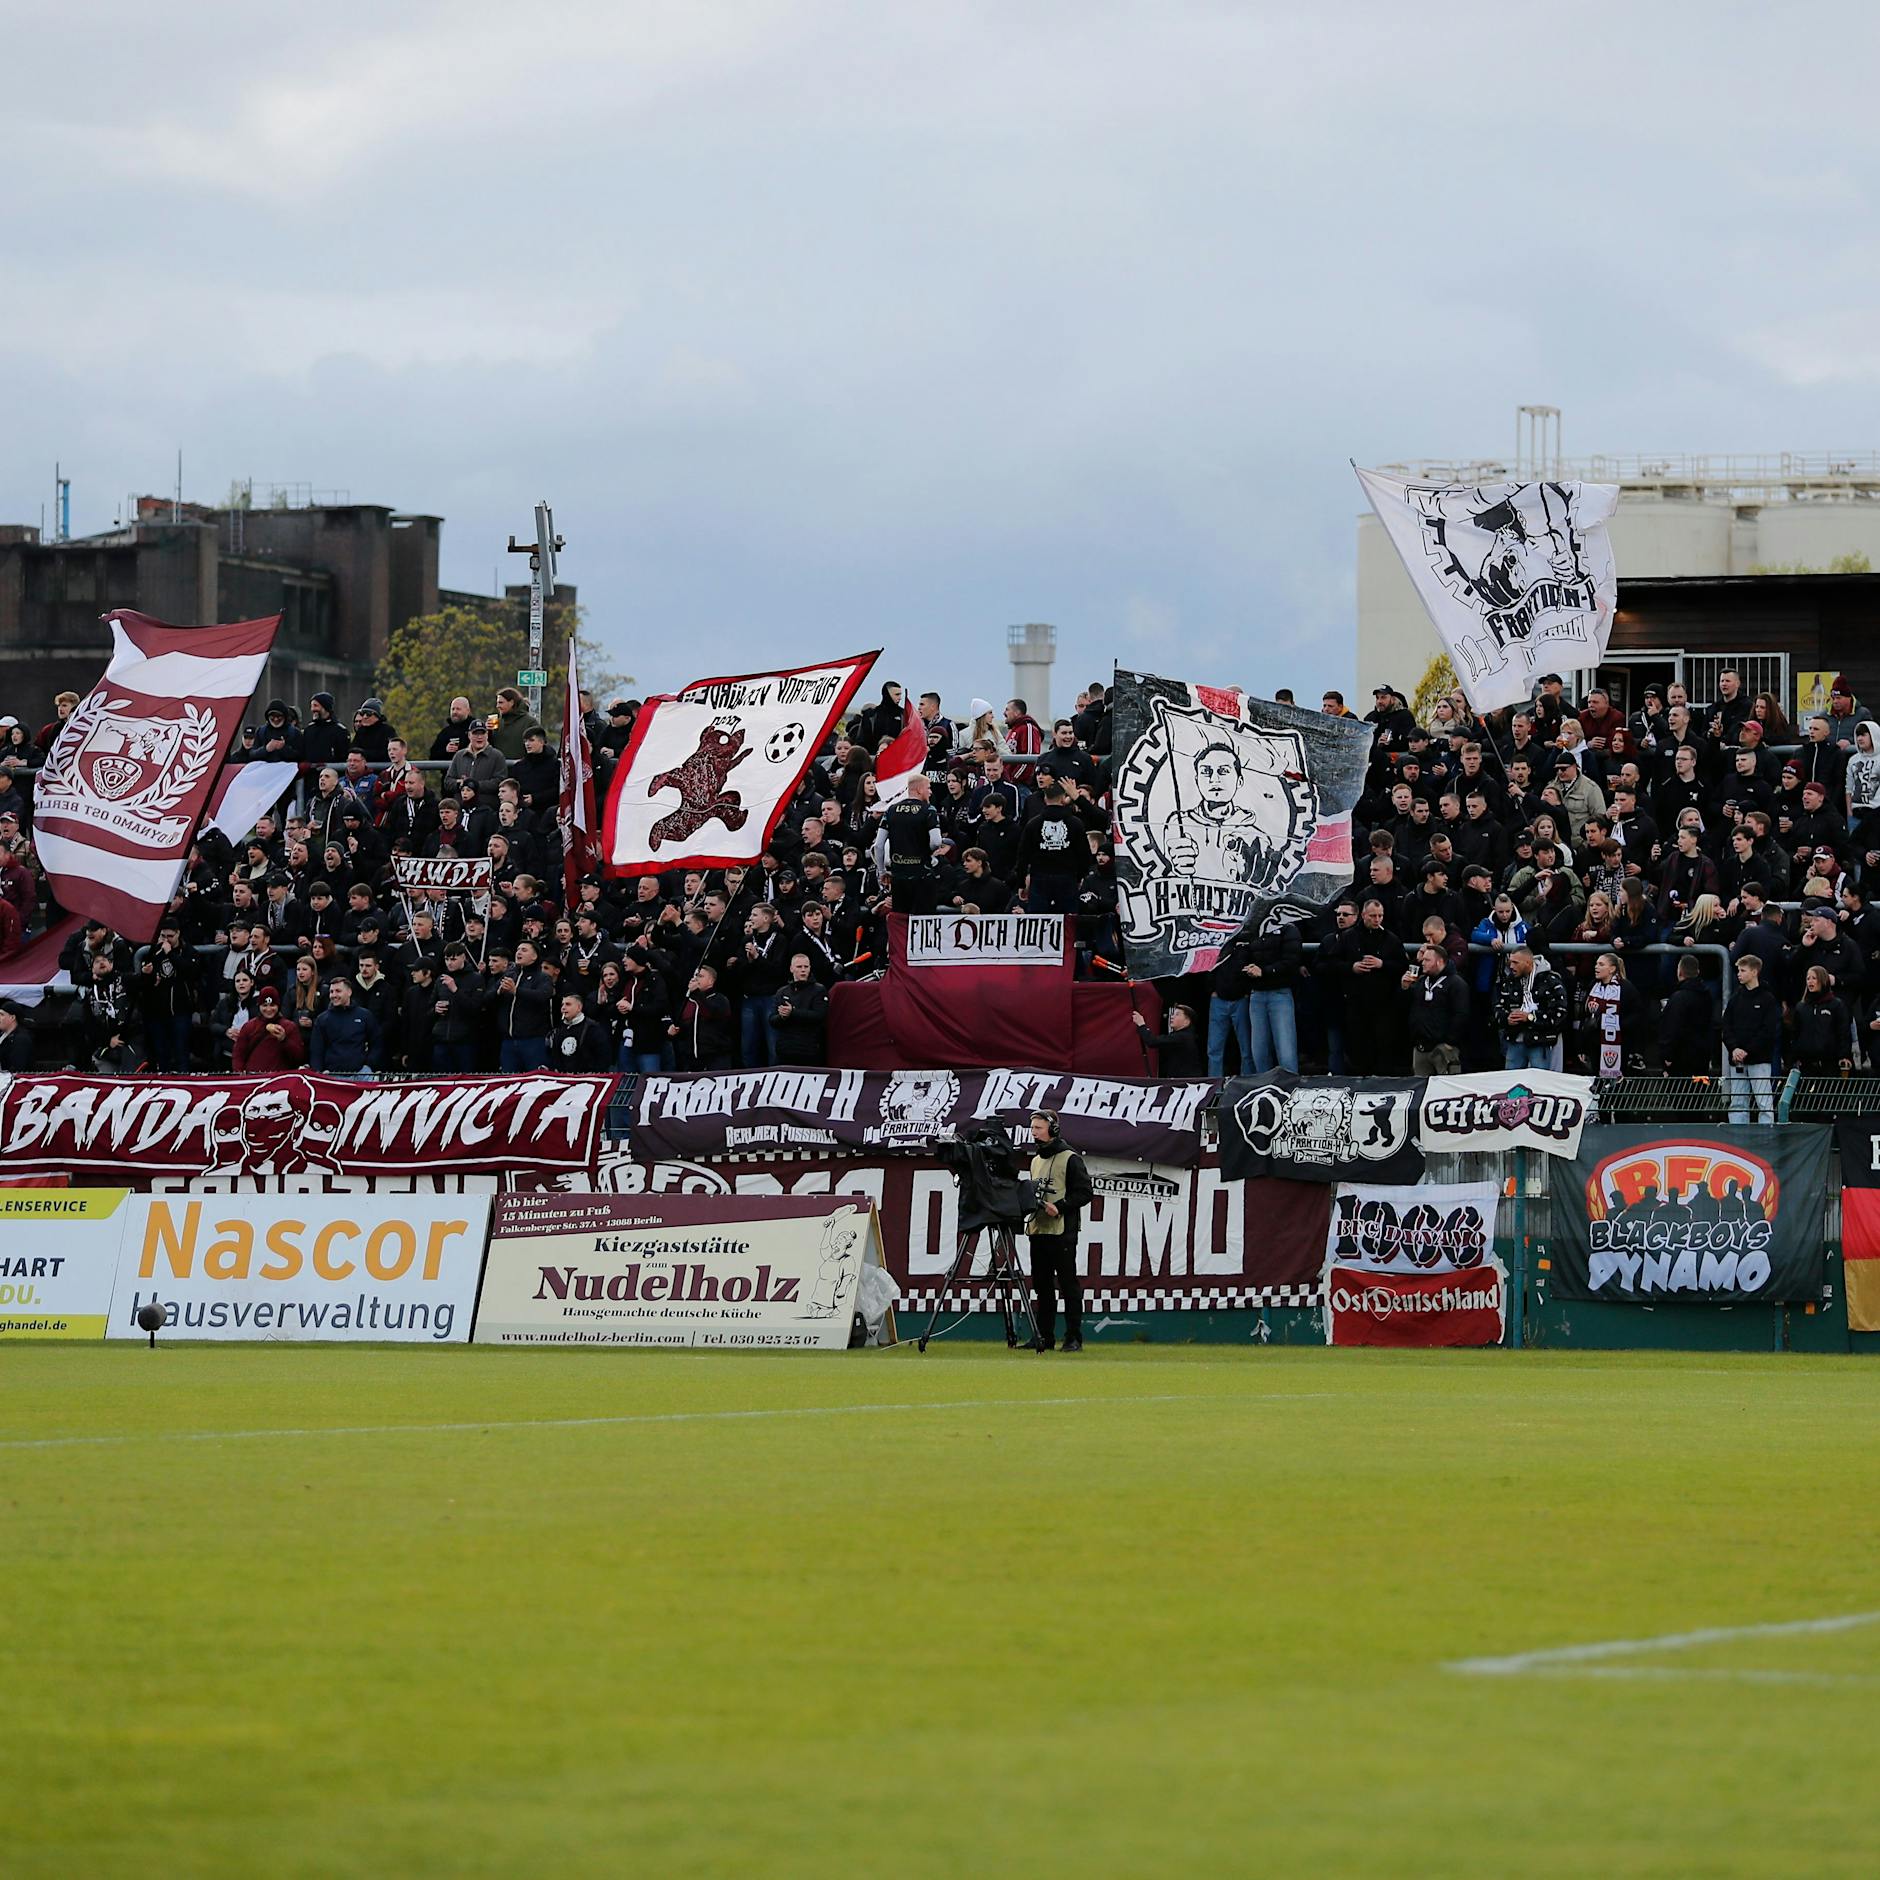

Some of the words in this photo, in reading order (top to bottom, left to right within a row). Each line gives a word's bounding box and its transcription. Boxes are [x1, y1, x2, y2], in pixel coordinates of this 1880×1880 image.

[895, 804, 911, 813] LFS
[910, 919, 944, 954] FICK
[948, 916, 1008, 952] DICH
[637, 1069, 866, 1127] FRAKTION-H
[970, 1068, 1064, 1120] OST
[1061, 1076, 1214, 1132] BERLIN
[0, 1085, 230, 1157] BANDA
[335, 1079, 595, 1156] INVICTA
[725, 1124, 779, 1147] BERLINER
[1289, 1136, 1342, 1152] FRAKTION-H
[502, 1212, 516, 1222] 15
[517, 1208, 568, 1221] Minuten
[569, 1209, 585, 1218] zu
[587, 1205, 612, 1217] Fuß
[503, 1198, 521, 1209] Ab
[524, 1197, 548, 1208] hier
[500, 1222, 563, 1235] Falkenberger
[562, 1221, 579, 1230] Str.
[579, 1219, 597, 1229] 37A
[606, 1216, 632, 1227] 13088
[633, 1214, 663, 1225] Berlin
[1384, 1224, 1487, 1248] DYNAMO
[1589, 1219, 1773, 1251] BLACKBOYS
[138, 1200, 469, 1281] Nascor
[594, 1236, 750, 1259] Kiezgaststätte
[532, 1263, 801, 1304] Nudelholz
[1587, 1250, 1771, 1294] DYNAMO
[130, 1292, 456, 1339] Hausverwaltung
[562, 1306, 658, 1320] Hausgemachte
[660, 1309, 718, 1319] deutsche
[720, 1308, 762, 1320] Küche
[501, 1331, 685, 1344] www.nudelholz-berlin.com
[702, 1334, 727, 1345] Tel.
[730, 1335, 755, 1346] 030
[758, 1335, 782, 1346] 925
[784, 1336, 801, 1346] 25
[803, 1336, 820, 1346] 07
